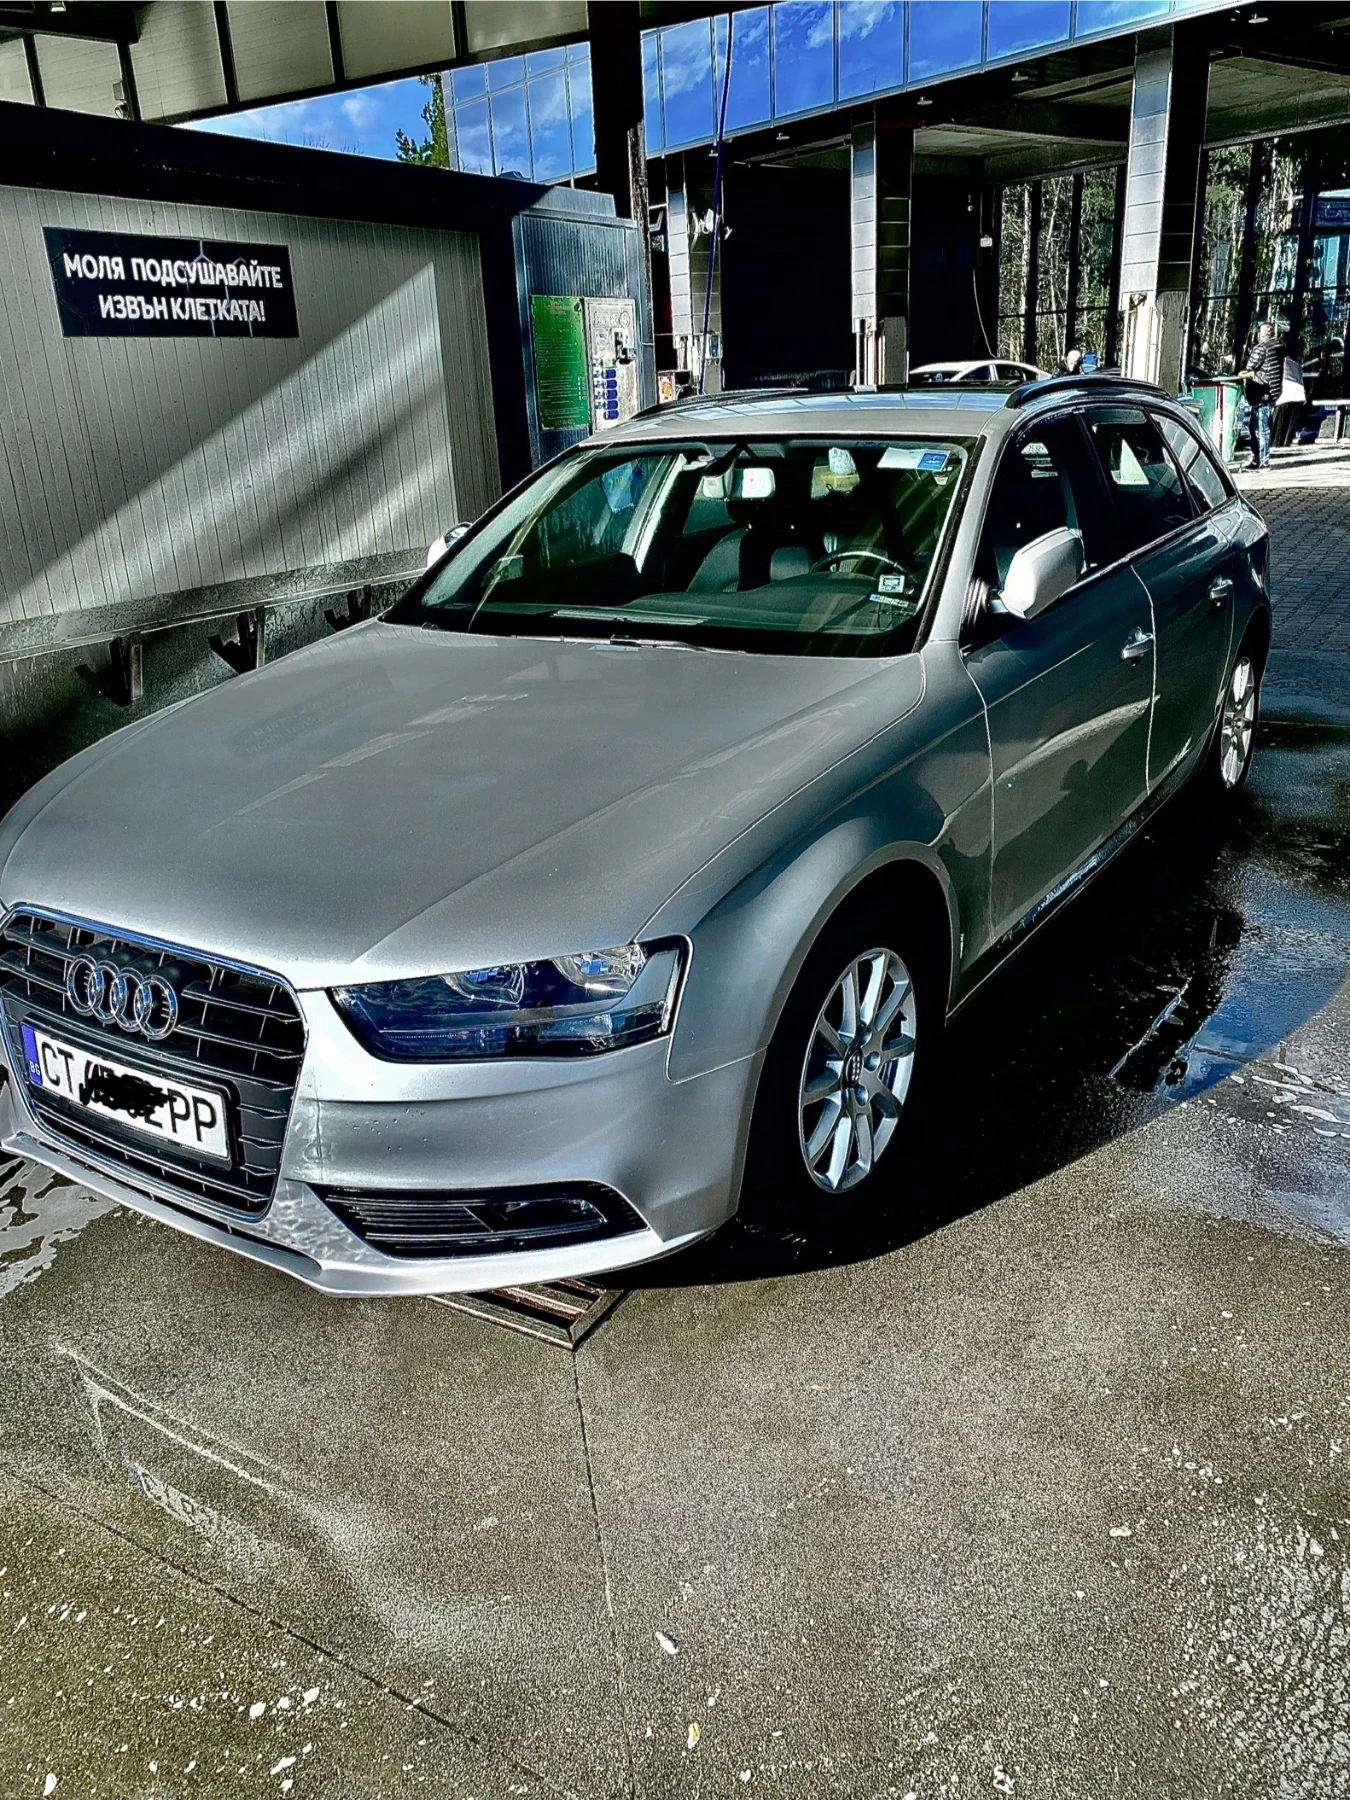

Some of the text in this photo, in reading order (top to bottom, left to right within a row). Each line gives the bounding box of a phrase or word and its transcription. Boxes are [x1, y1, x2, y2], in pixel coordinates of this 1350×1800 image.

[63, 253, 283, 288] МОЛЯ ПОДСУШАВАЙТЕ
[98, 294, 266, 321] ИЗВЪН КЛЕТКАТА!
[29, 1060, 41, 1076] BG
